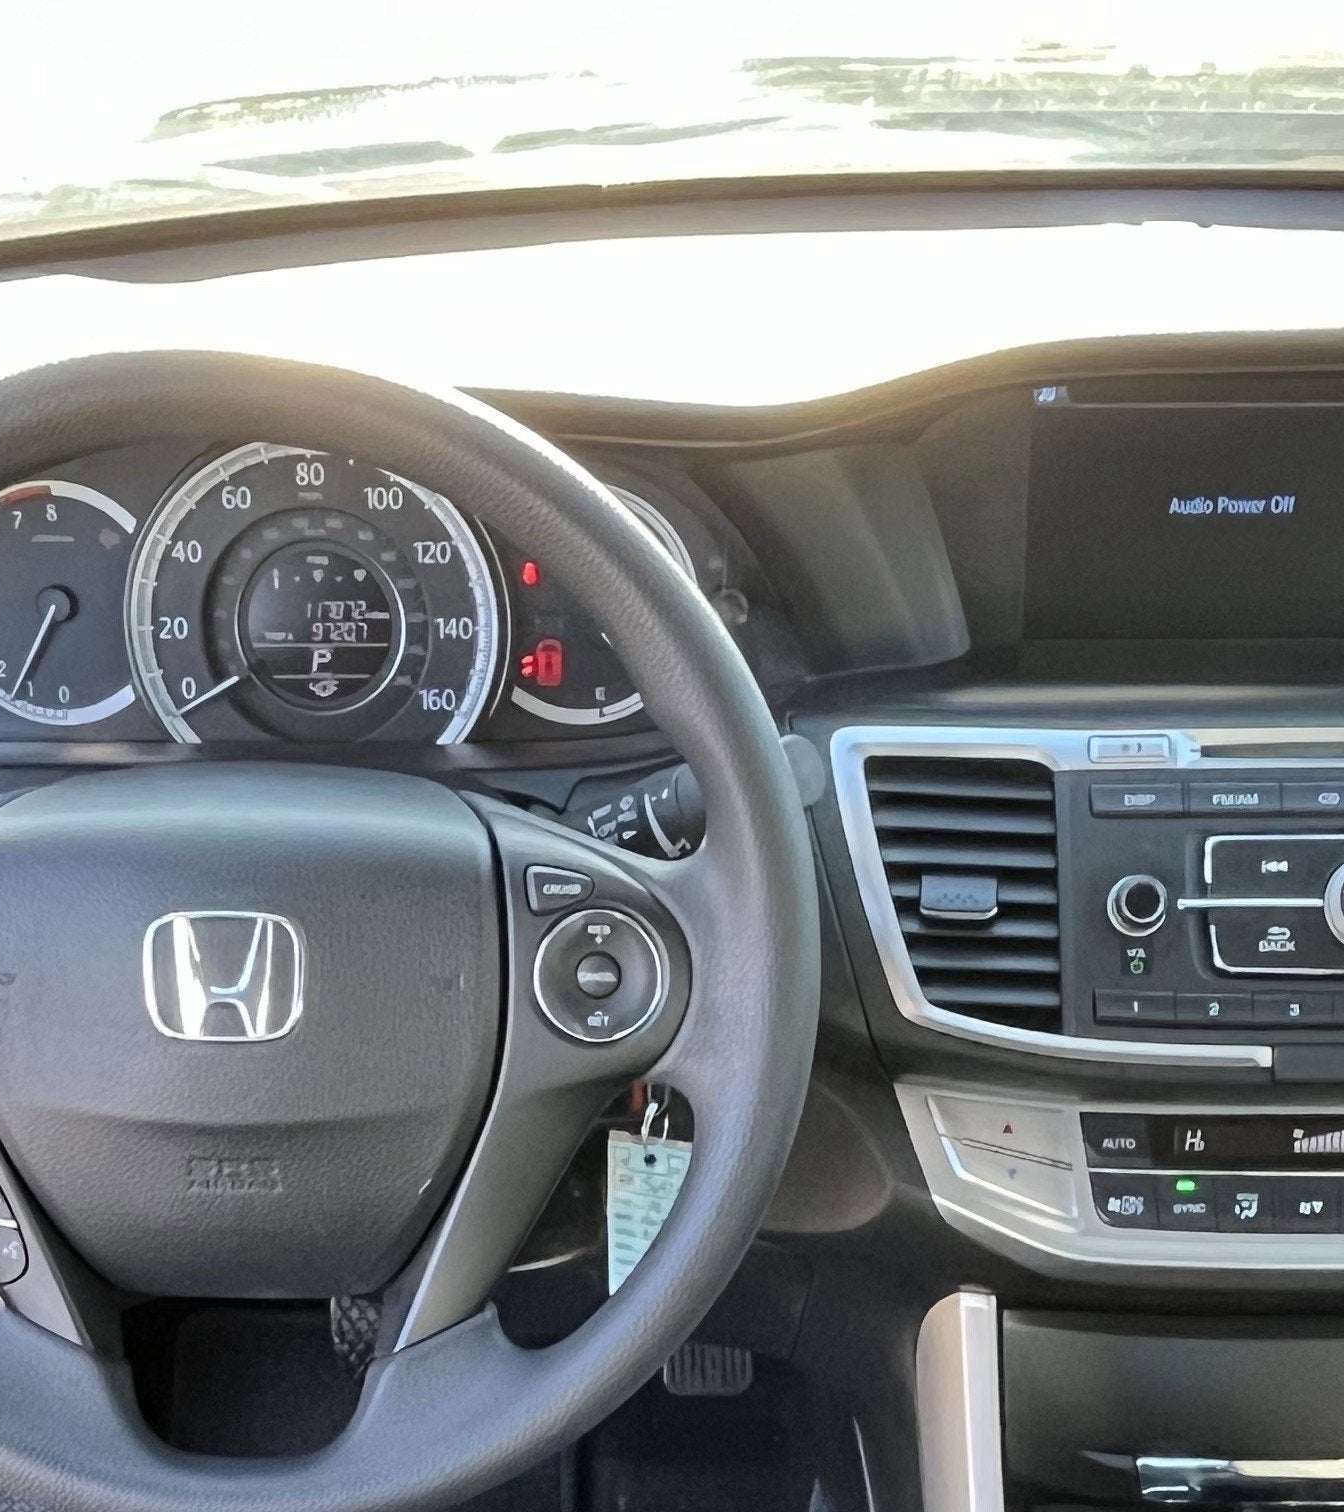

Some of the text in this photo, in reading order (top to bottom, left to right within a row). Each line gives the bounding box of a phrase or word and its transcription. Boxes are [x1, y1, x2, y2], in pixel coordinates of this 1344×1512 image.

[296, 462, 325, 486] 80
[221, 486, 251, 510] 60
[363, 487, 403, 510] 100
[1169, 495, 1295, 515] Audio Power Off
[12, 510, 22, 530] 7
[46, 504, 57, 521] 8
[171, 540, 202, 563] 40
[413, 541, 452, 565] 120
[158, 617, 188, 640] 20
[436, 618, 472, 640] 140
[312, 649, 332, 673] P
[27, 681, 33, 697] 1
[58, 685, 69, 703] 0
[181, 677, 197, 699] 0
[419, 689, 455, 712] 160
[1132, 1001, 1139, 1014] 1
[1208, 1002, 1220, 1016] 2
[1289, 1003, 1301, 1016] 3
[1102, 1138, 1136, 1150] AUTO
